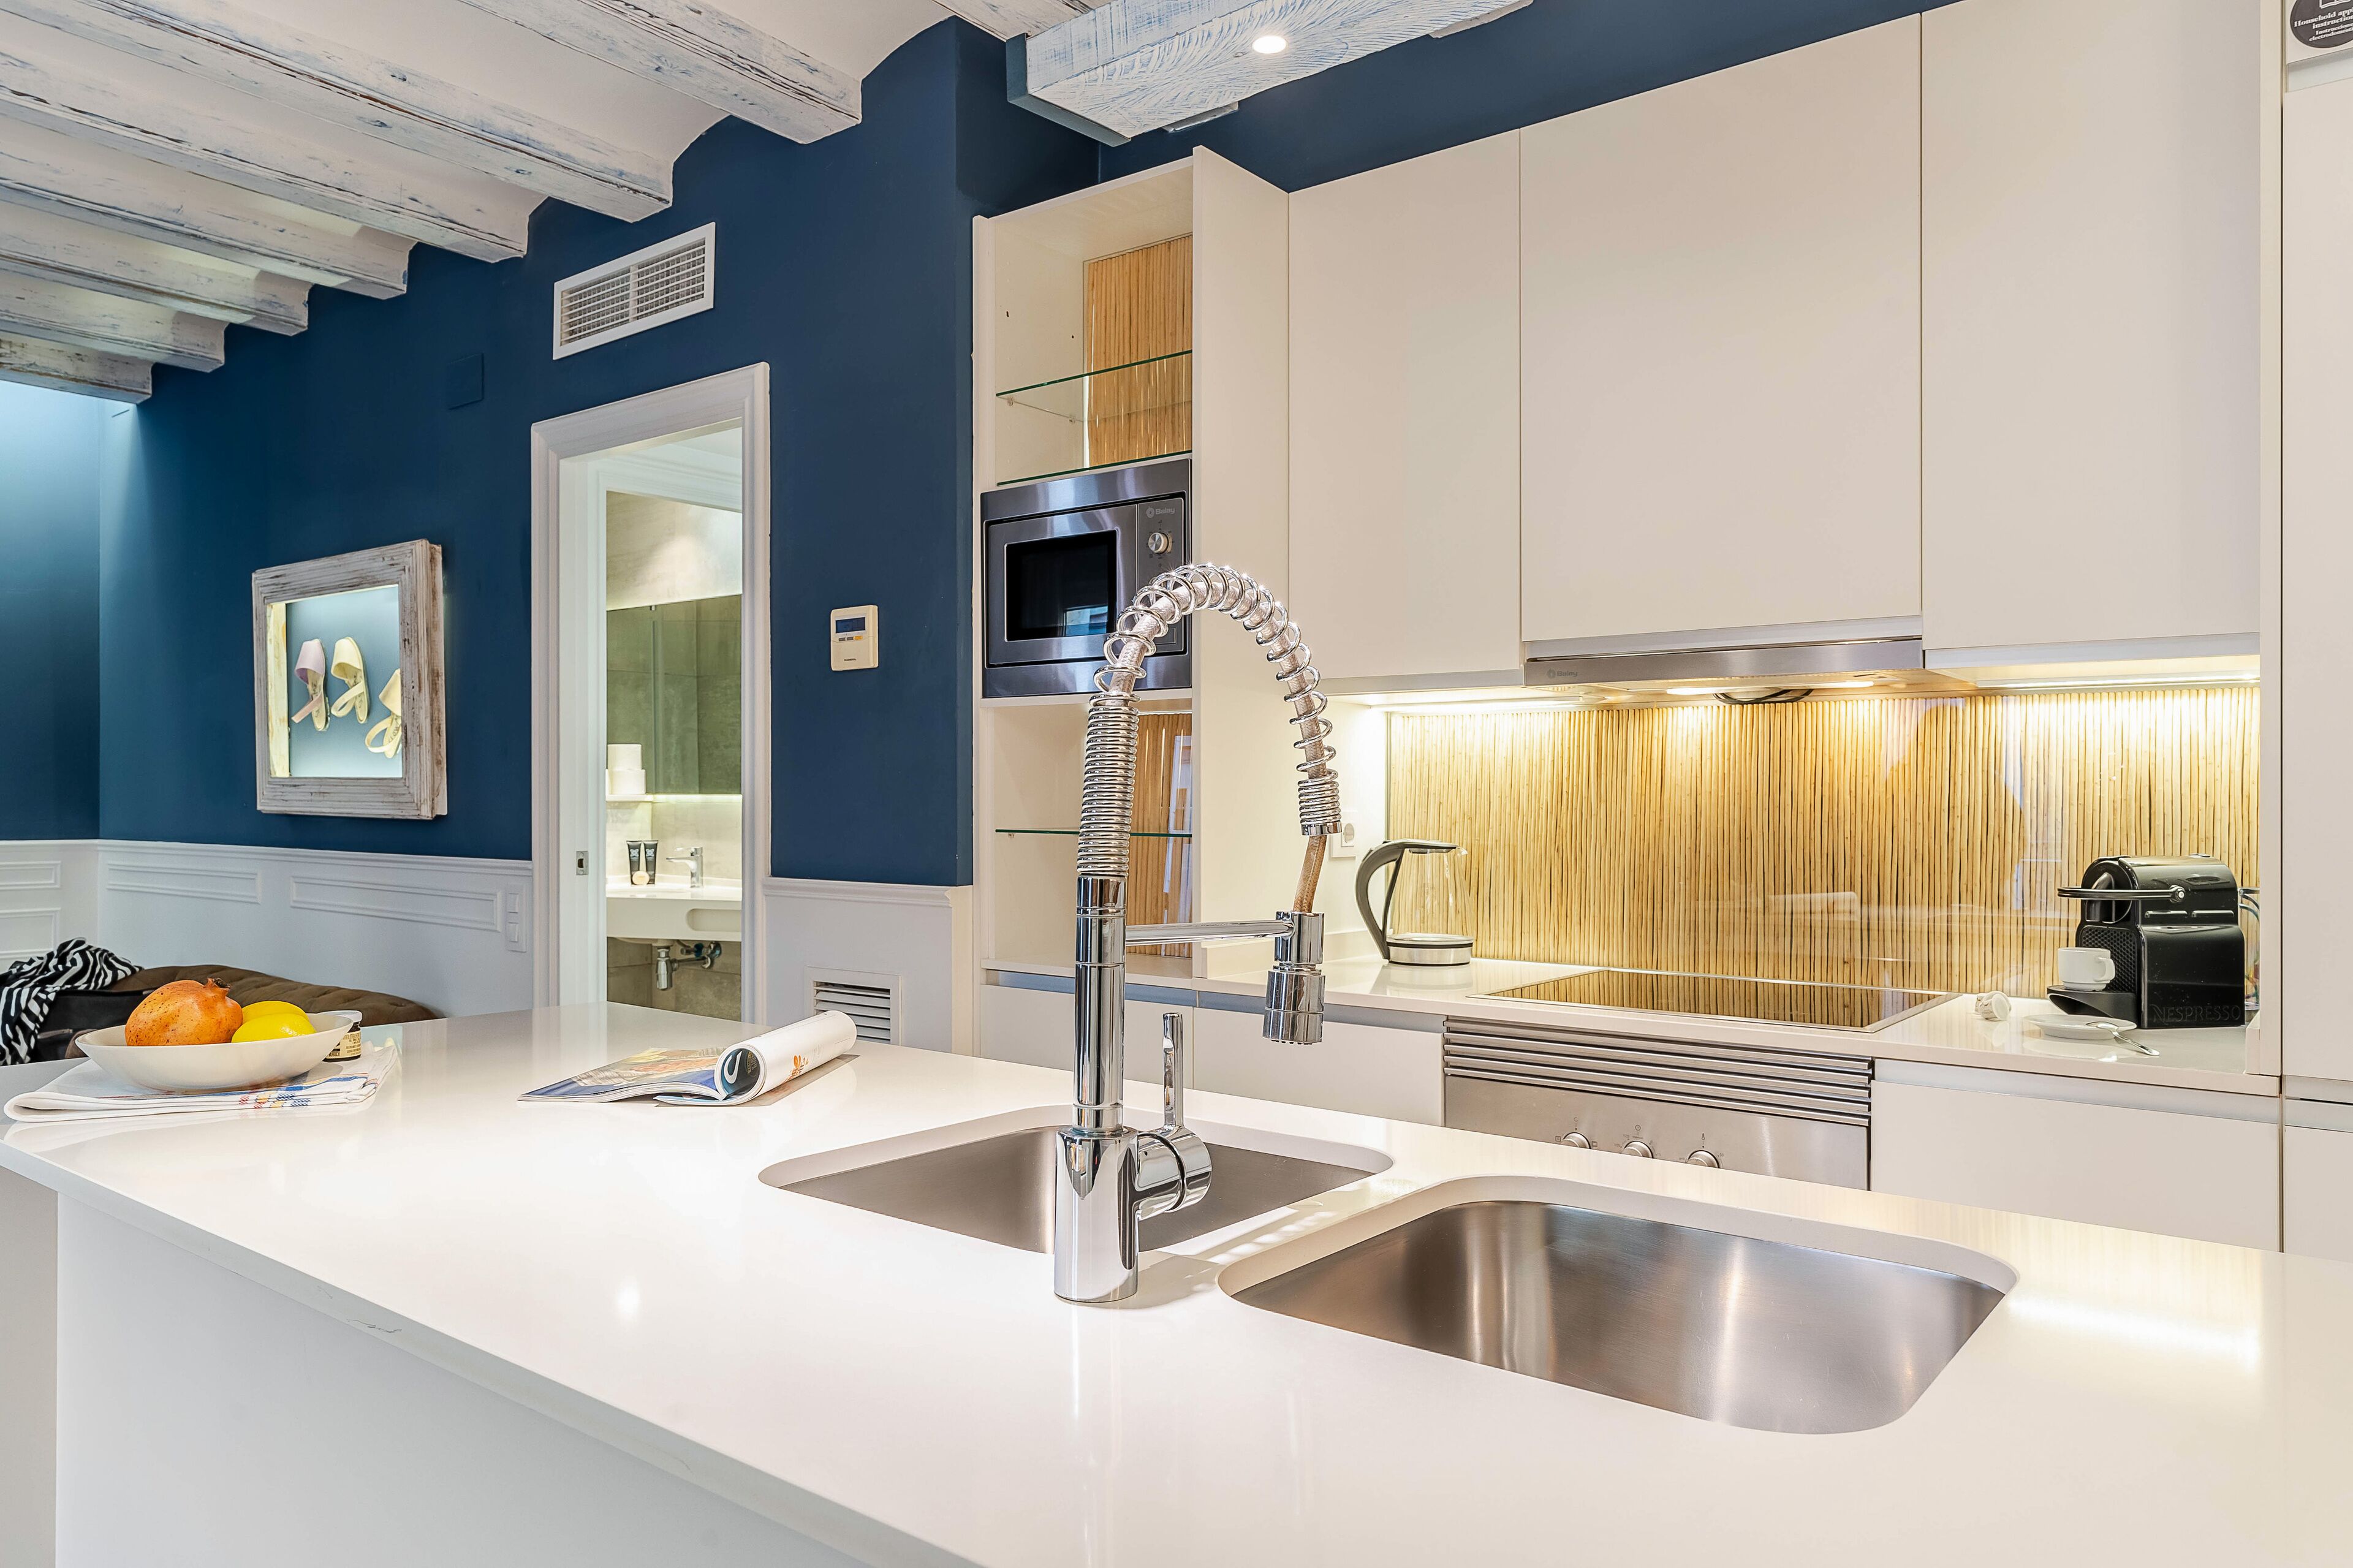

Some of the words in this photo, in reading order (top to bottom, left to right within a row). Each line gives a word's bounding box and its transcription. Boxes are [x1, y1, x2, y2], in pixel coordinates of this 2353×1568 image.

[2294, 11, 2336, 28] Household
[2338, 7, 2353, 17] app
[2149, 1004, 2241, 1025] NESPRESSO
